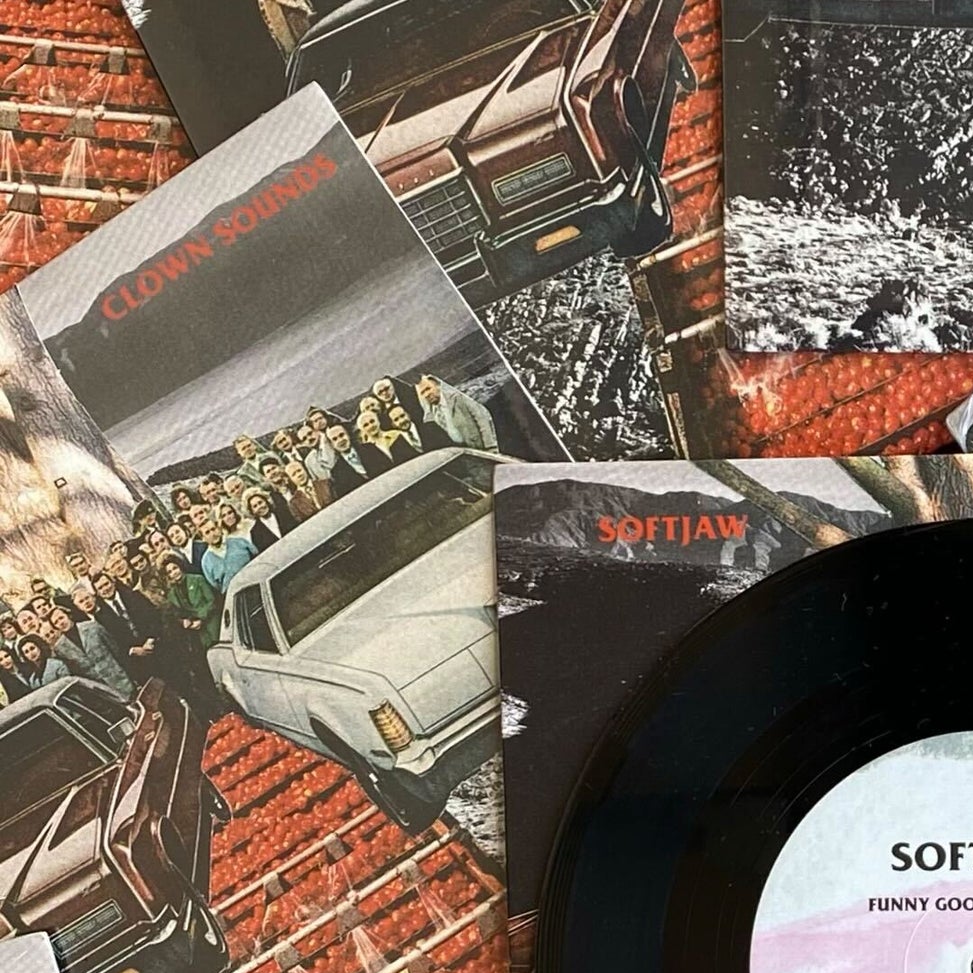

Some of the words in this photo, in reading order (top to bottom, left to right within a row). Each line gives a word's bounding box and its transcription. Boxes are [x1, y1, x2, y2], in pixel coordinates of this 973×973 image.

[102, 232, 214, 320] CLOWN
[212, 152, 338, 246] SOUNDS
[598, 514, 749, 546] SOFTJAW
[868, 897, 930, 912] FUNNY
